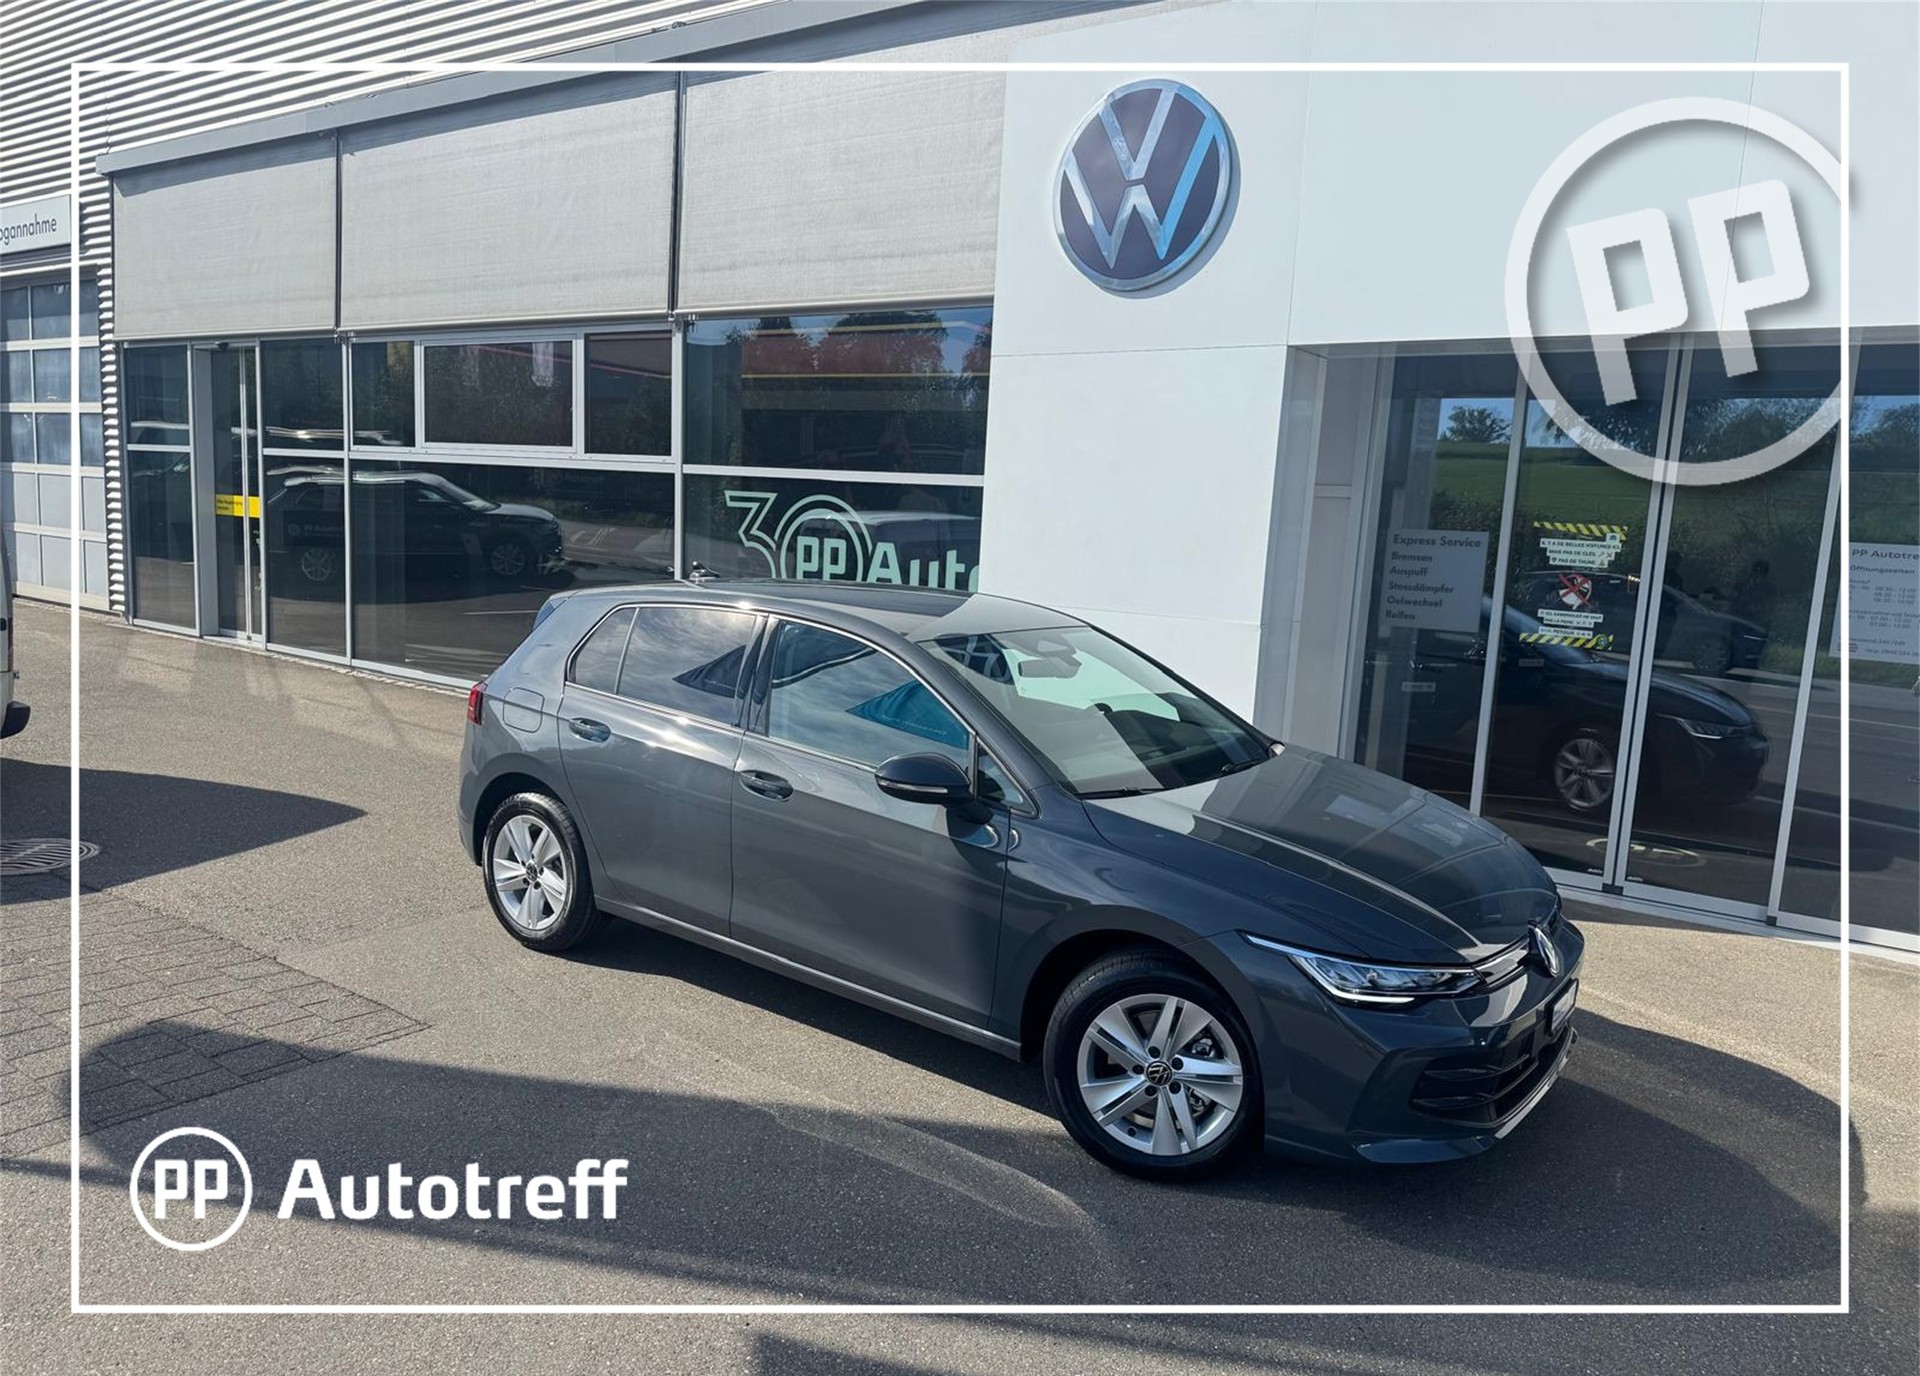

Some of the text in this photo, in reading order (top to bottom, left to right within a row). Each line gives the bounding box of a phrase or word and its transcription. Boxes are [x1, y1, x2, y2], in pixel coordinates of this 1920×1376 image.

[1393, 533, 1481, 548] Express Service
[1391, 551, 1433, 562] Bremsen
[1852, 549, 1868, 557] PP
[1390, 566, 1430, 578] Auspuff
[1388, 581, 1455, 595] Stossdämpfer
[1387, 596, 1443, 608] Oelwechsel
[1385, 609, 1416, 621] Reifen
